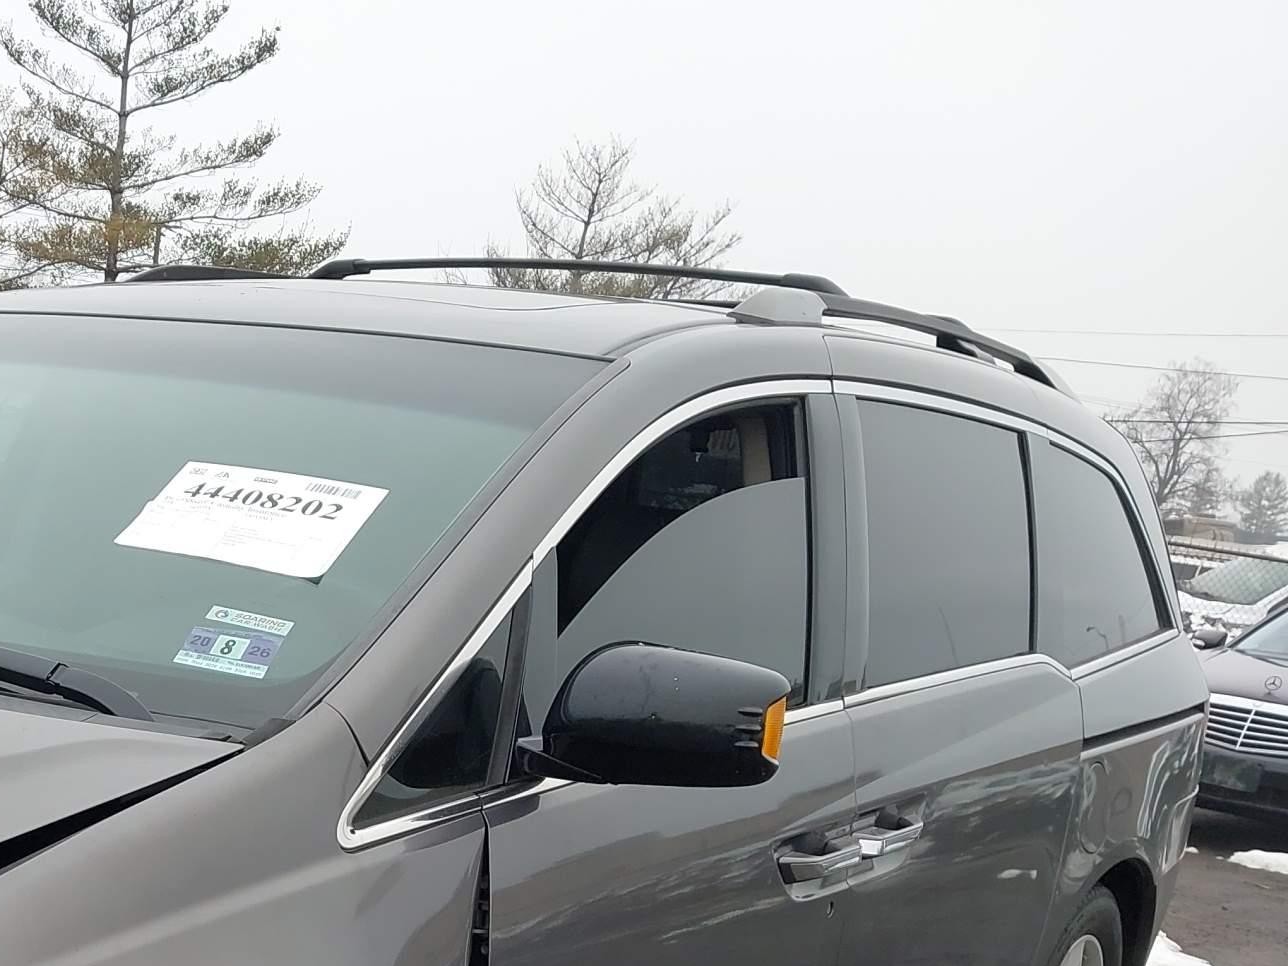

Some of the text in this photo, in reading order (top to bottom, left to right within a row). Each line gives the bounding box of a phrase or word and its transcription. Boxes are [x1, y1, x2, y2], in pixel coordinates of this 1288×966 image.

[183, 481, 344, 521] 44408202
[233, 612, 289, 628] SOARING
[190, 634, 213, 648] 20
[219, 639, 237, 656] 8
[247, 645, 273, 659] 26
